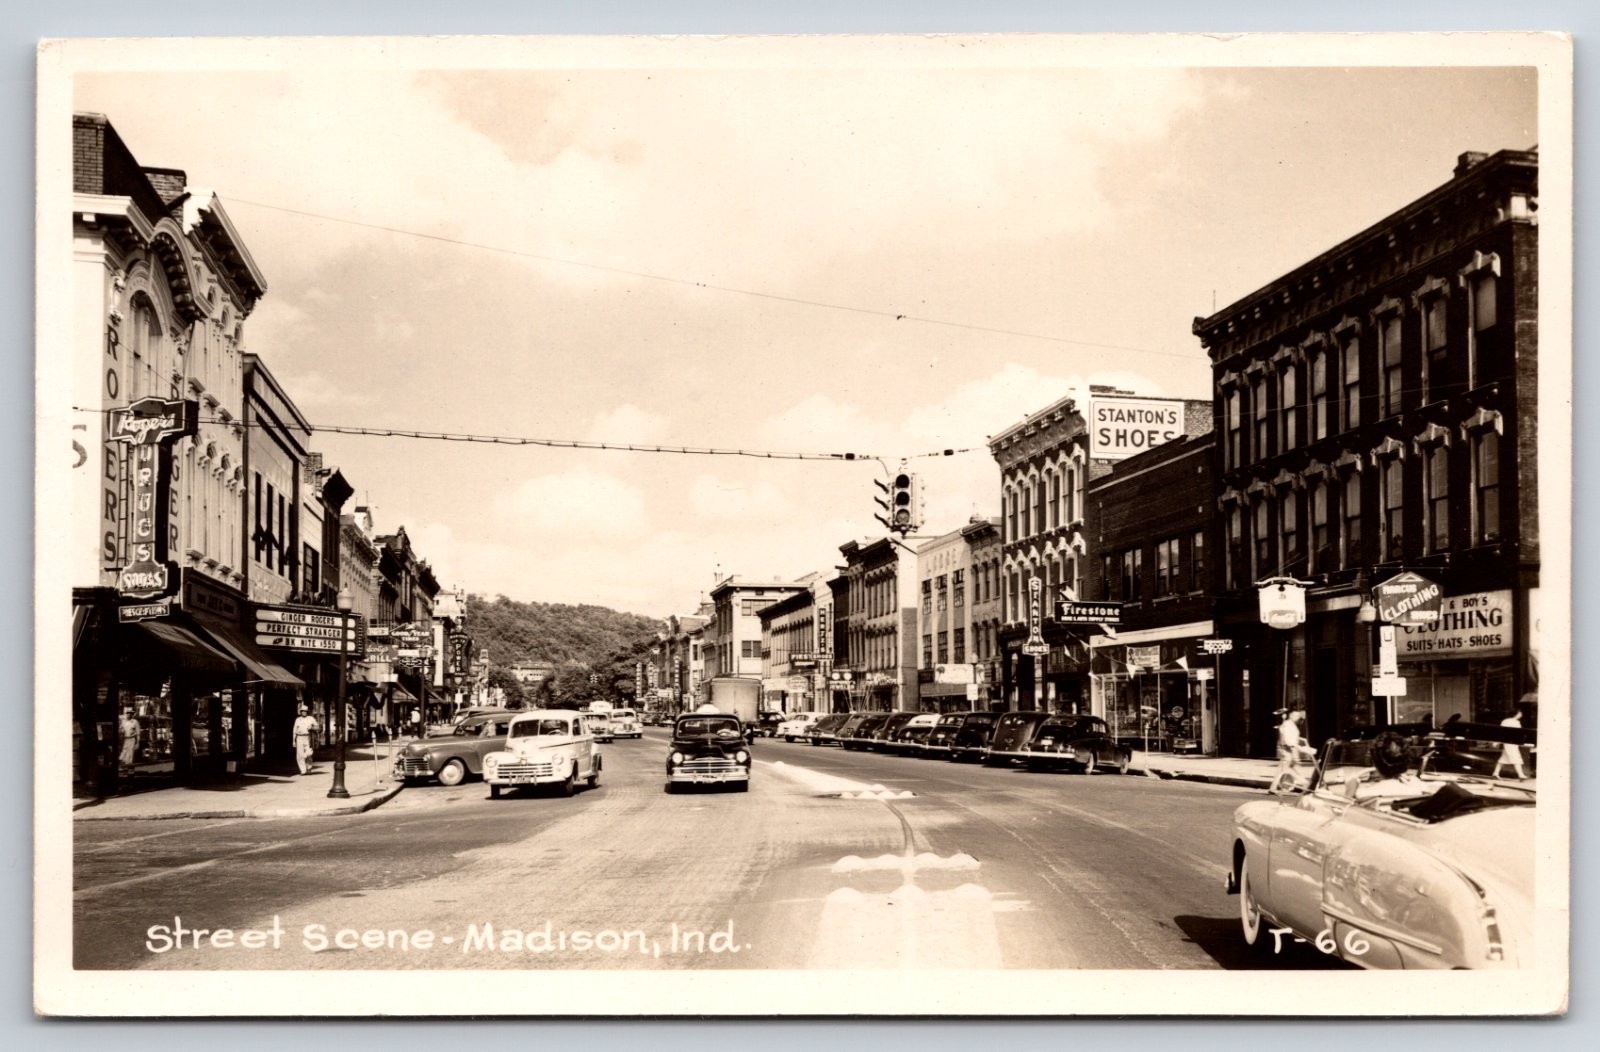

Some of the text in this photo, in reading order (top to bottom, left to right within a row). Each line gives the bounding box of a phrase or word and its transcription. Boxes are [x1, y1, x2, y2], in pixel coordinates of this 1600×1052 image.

[1098, 408, 1177, 424] STANTON'S
[104, 324, 119, 562] ROERS
[1098, 428, 1175, 448] SHOES
[1061, 603, 1120, 615] Firestone
[1384, 584, 1439, 621] CLOTHING
[281, 613, 335, 625] GINGER ROGERS
[1031, 581, 1039, 643] STANTON
[266, 624, 301, 634] PERFECT
[301, 639, 316, 647] NITE
[1470, 634, 1501, 647] SHOES
